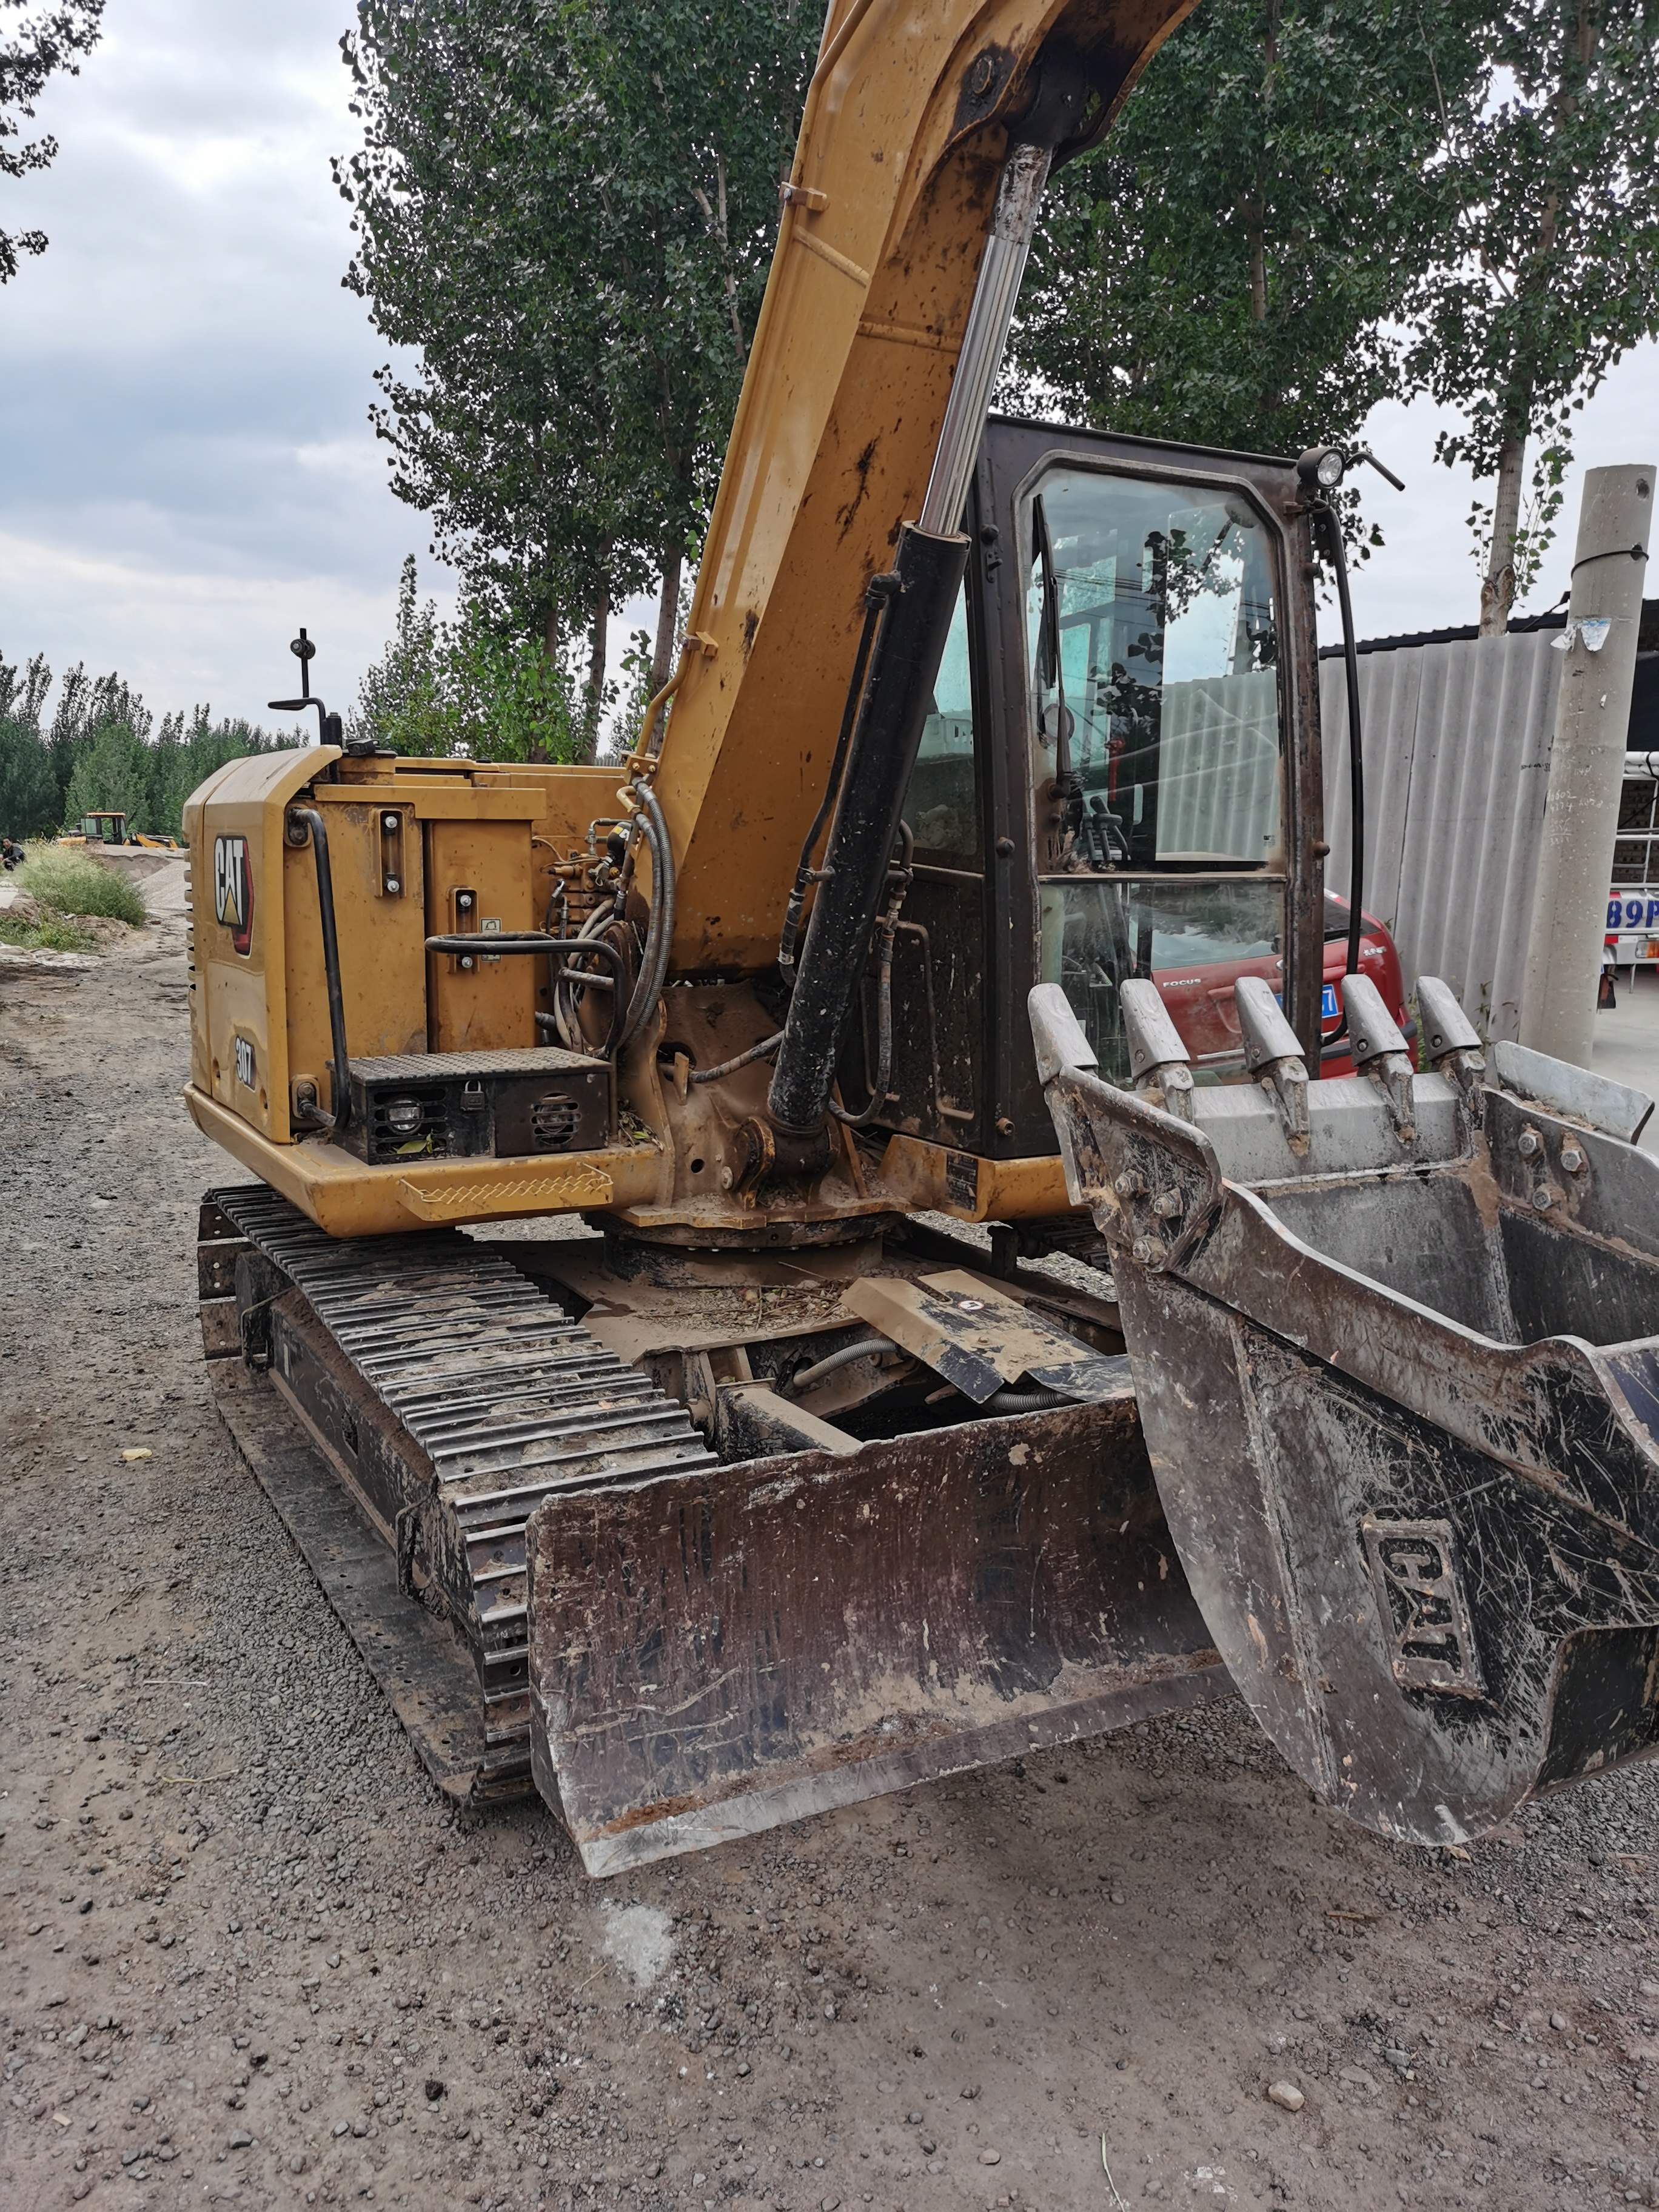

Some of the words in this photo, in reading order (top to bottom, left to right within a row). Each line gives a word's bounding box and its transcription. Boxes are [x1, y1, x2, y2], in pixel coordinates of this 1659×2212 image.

[215, 838, 243, 925] CAT
[1163, 978, 1201, 988] FOCUS
[1322, 989, 1333, 1011] 7
[236, 1037, 252, 1085] 307
[1377, 1535, 1465, 1678] CAT
